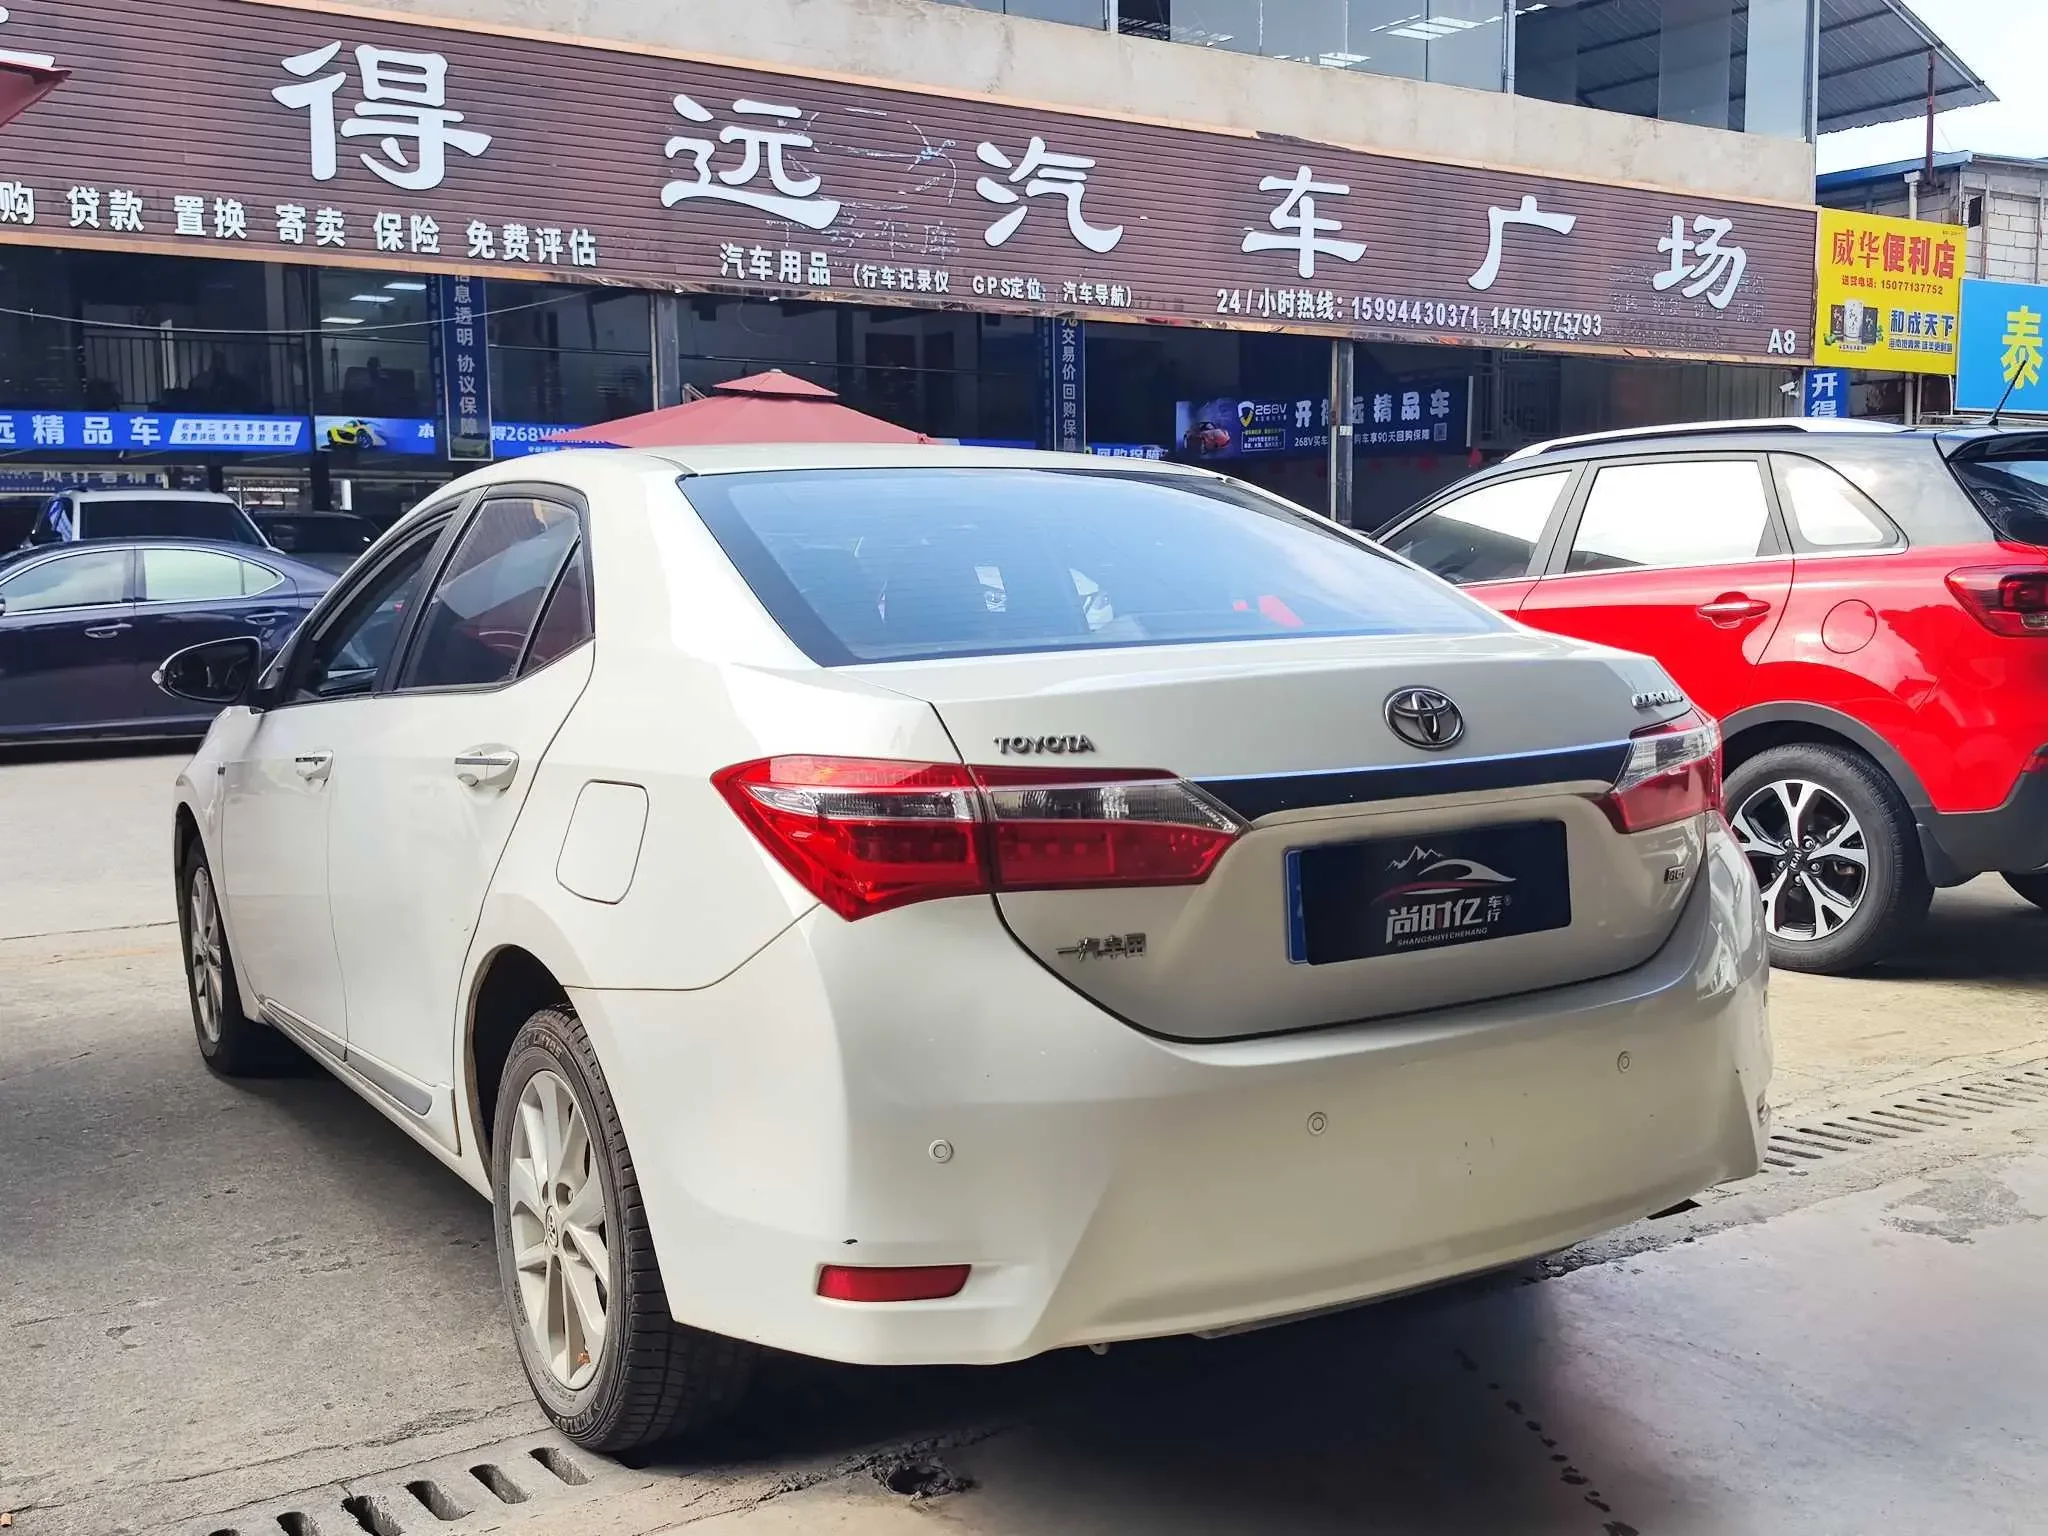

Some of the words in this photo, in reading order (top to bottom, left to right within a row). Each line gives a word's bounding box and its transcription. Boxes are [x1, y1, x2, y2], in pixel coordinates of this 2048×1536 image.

[66, 186, 145, 232] 贷款
[173, 195, 247, 239] 置换
[275, 203, 346, 247] 寄卖
[373, 211, 441, 254] 保险
[466, 220, 597, 266] 免费评估
[719, 243, 831, 287] 汽车用品
[1832, 229, 1956, 280] 威华便利店
[1490, 307, 1601, 336] 14795775793
[1890, 309, 1955, 337] 和成天下
[1767, 329, 1797, 355] A8
[2000, 305, 2043, 389] 泰
[992, 734, 1096, 754] TOYOTA
